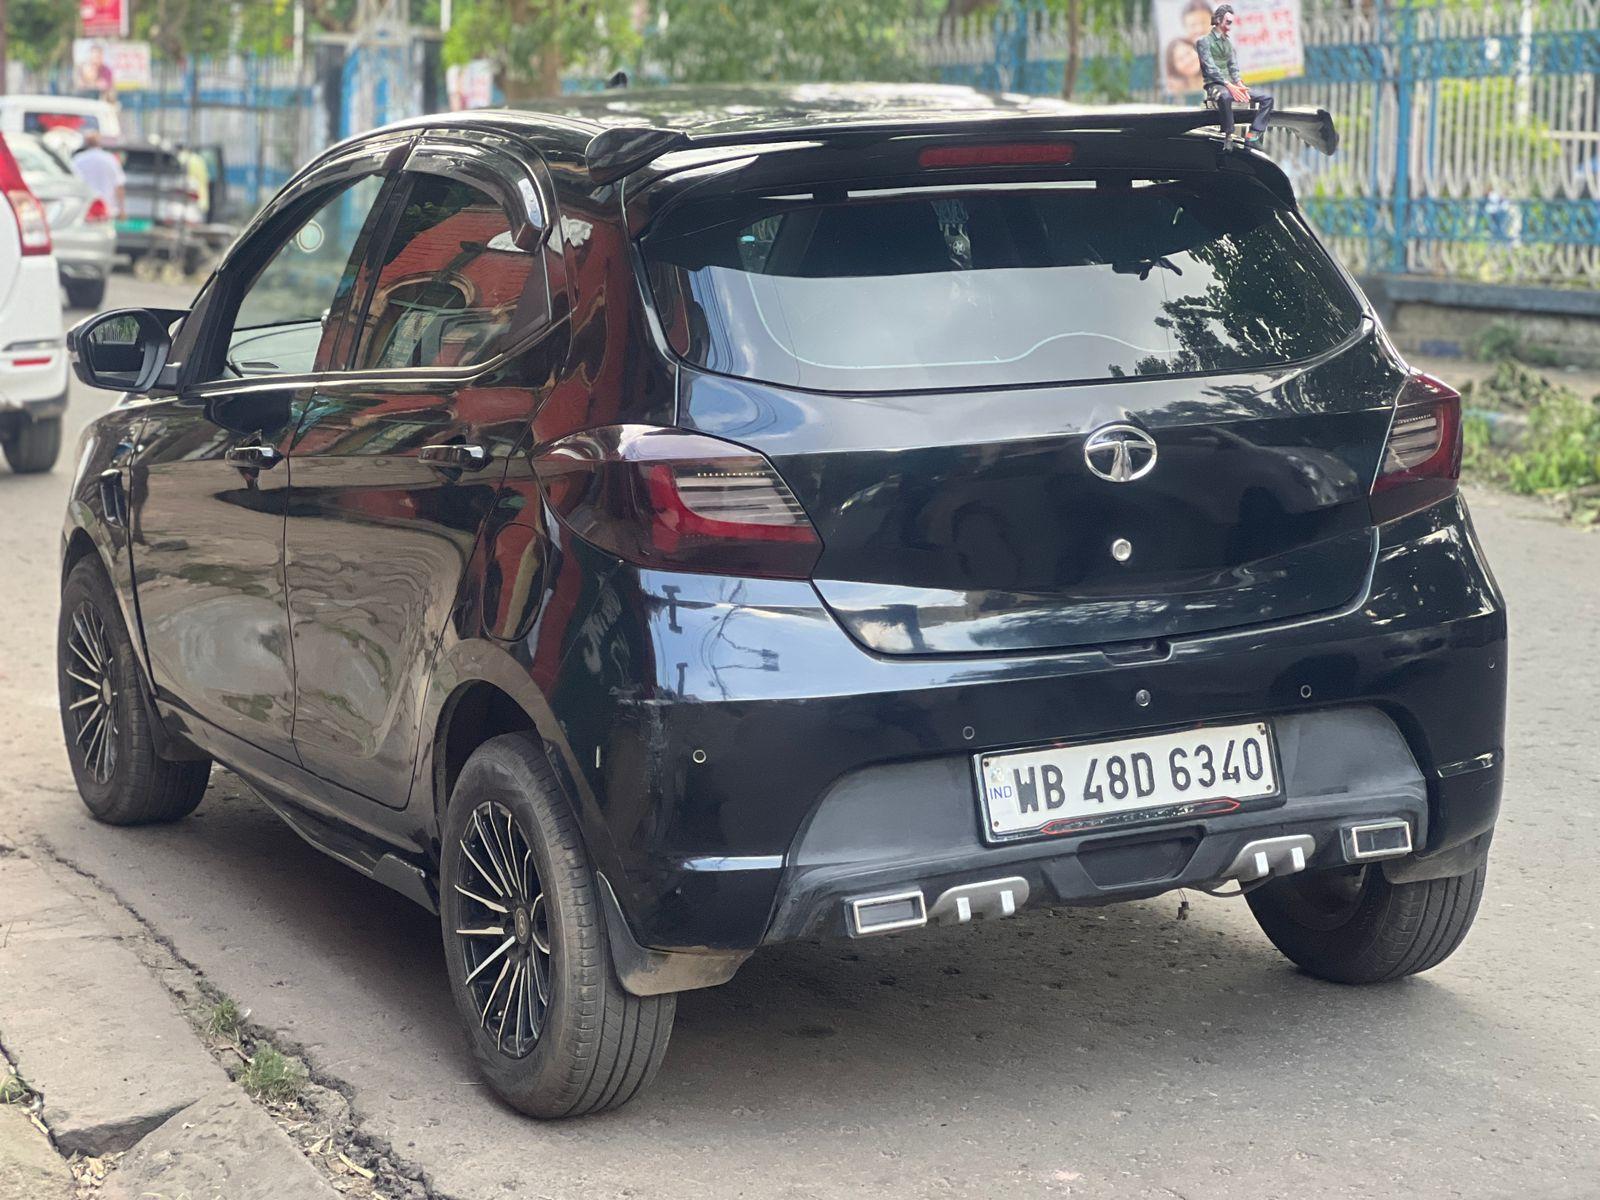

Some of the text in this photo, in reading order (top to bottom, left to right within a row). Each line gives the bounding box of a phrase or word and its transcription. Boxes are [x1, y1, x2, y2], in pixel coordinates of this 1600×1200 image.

[989, 785, 1013, 800] IND
[1013, 737, 1263, 814] WB 48D 6340
